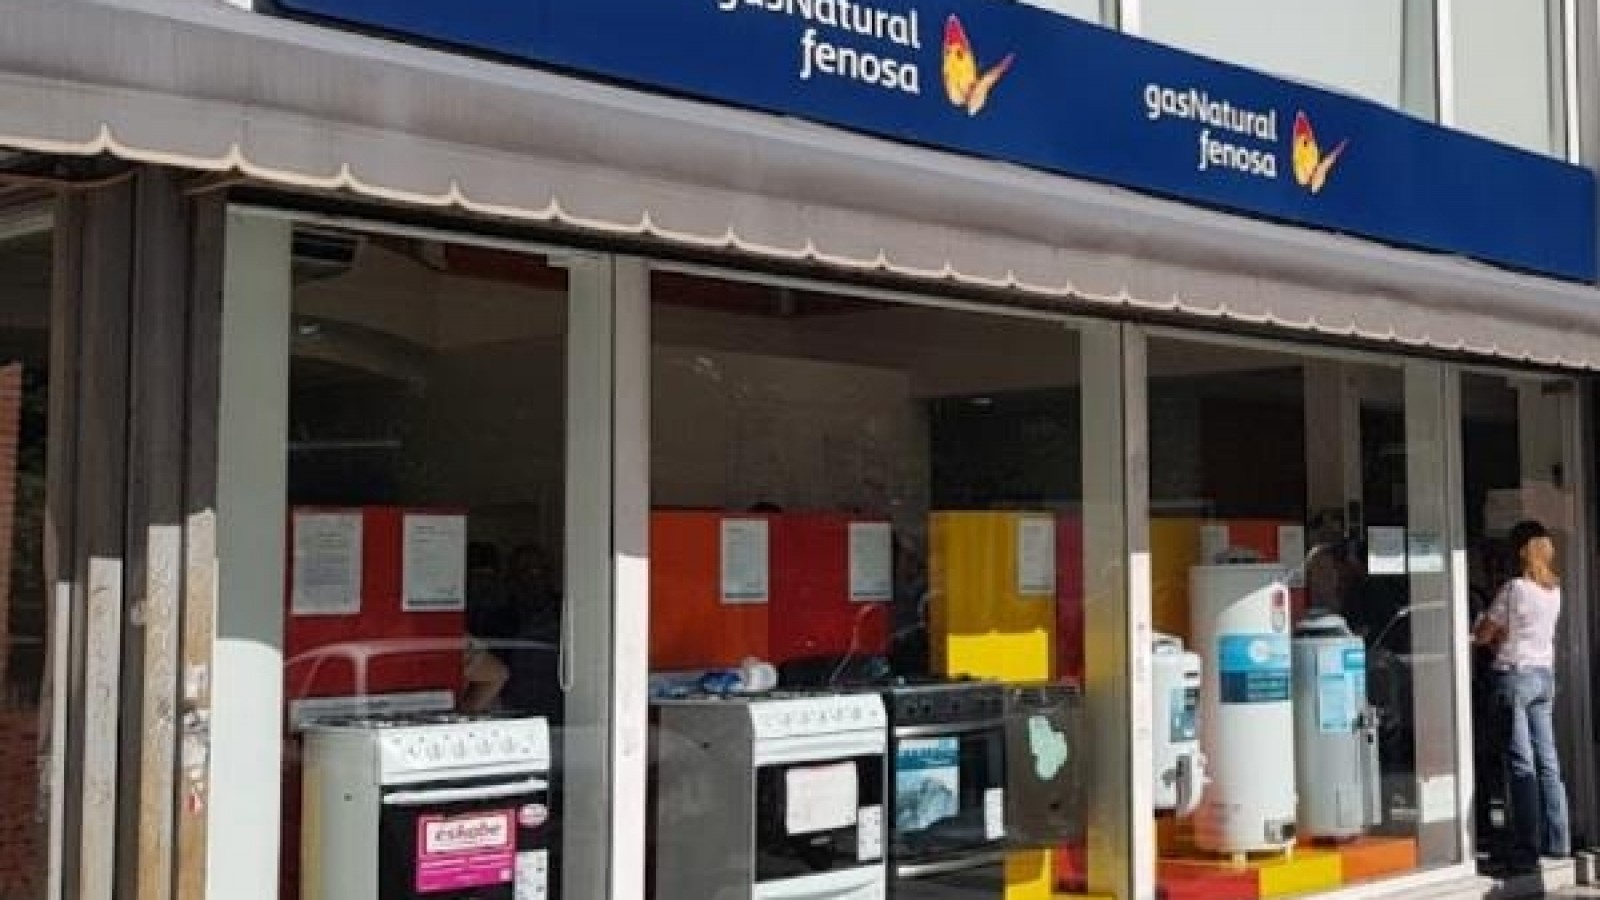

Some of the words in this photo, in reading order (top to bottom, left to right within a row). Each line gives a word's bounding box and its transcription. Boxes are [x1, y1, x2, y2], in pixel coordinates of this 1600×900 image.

[718, 0, 921, 49] atural
[799, 29, 920, 94] fenosa
[1144, 84, 1277, 141] gasNatural
[1198, 129, 1277, 177] fenosa
